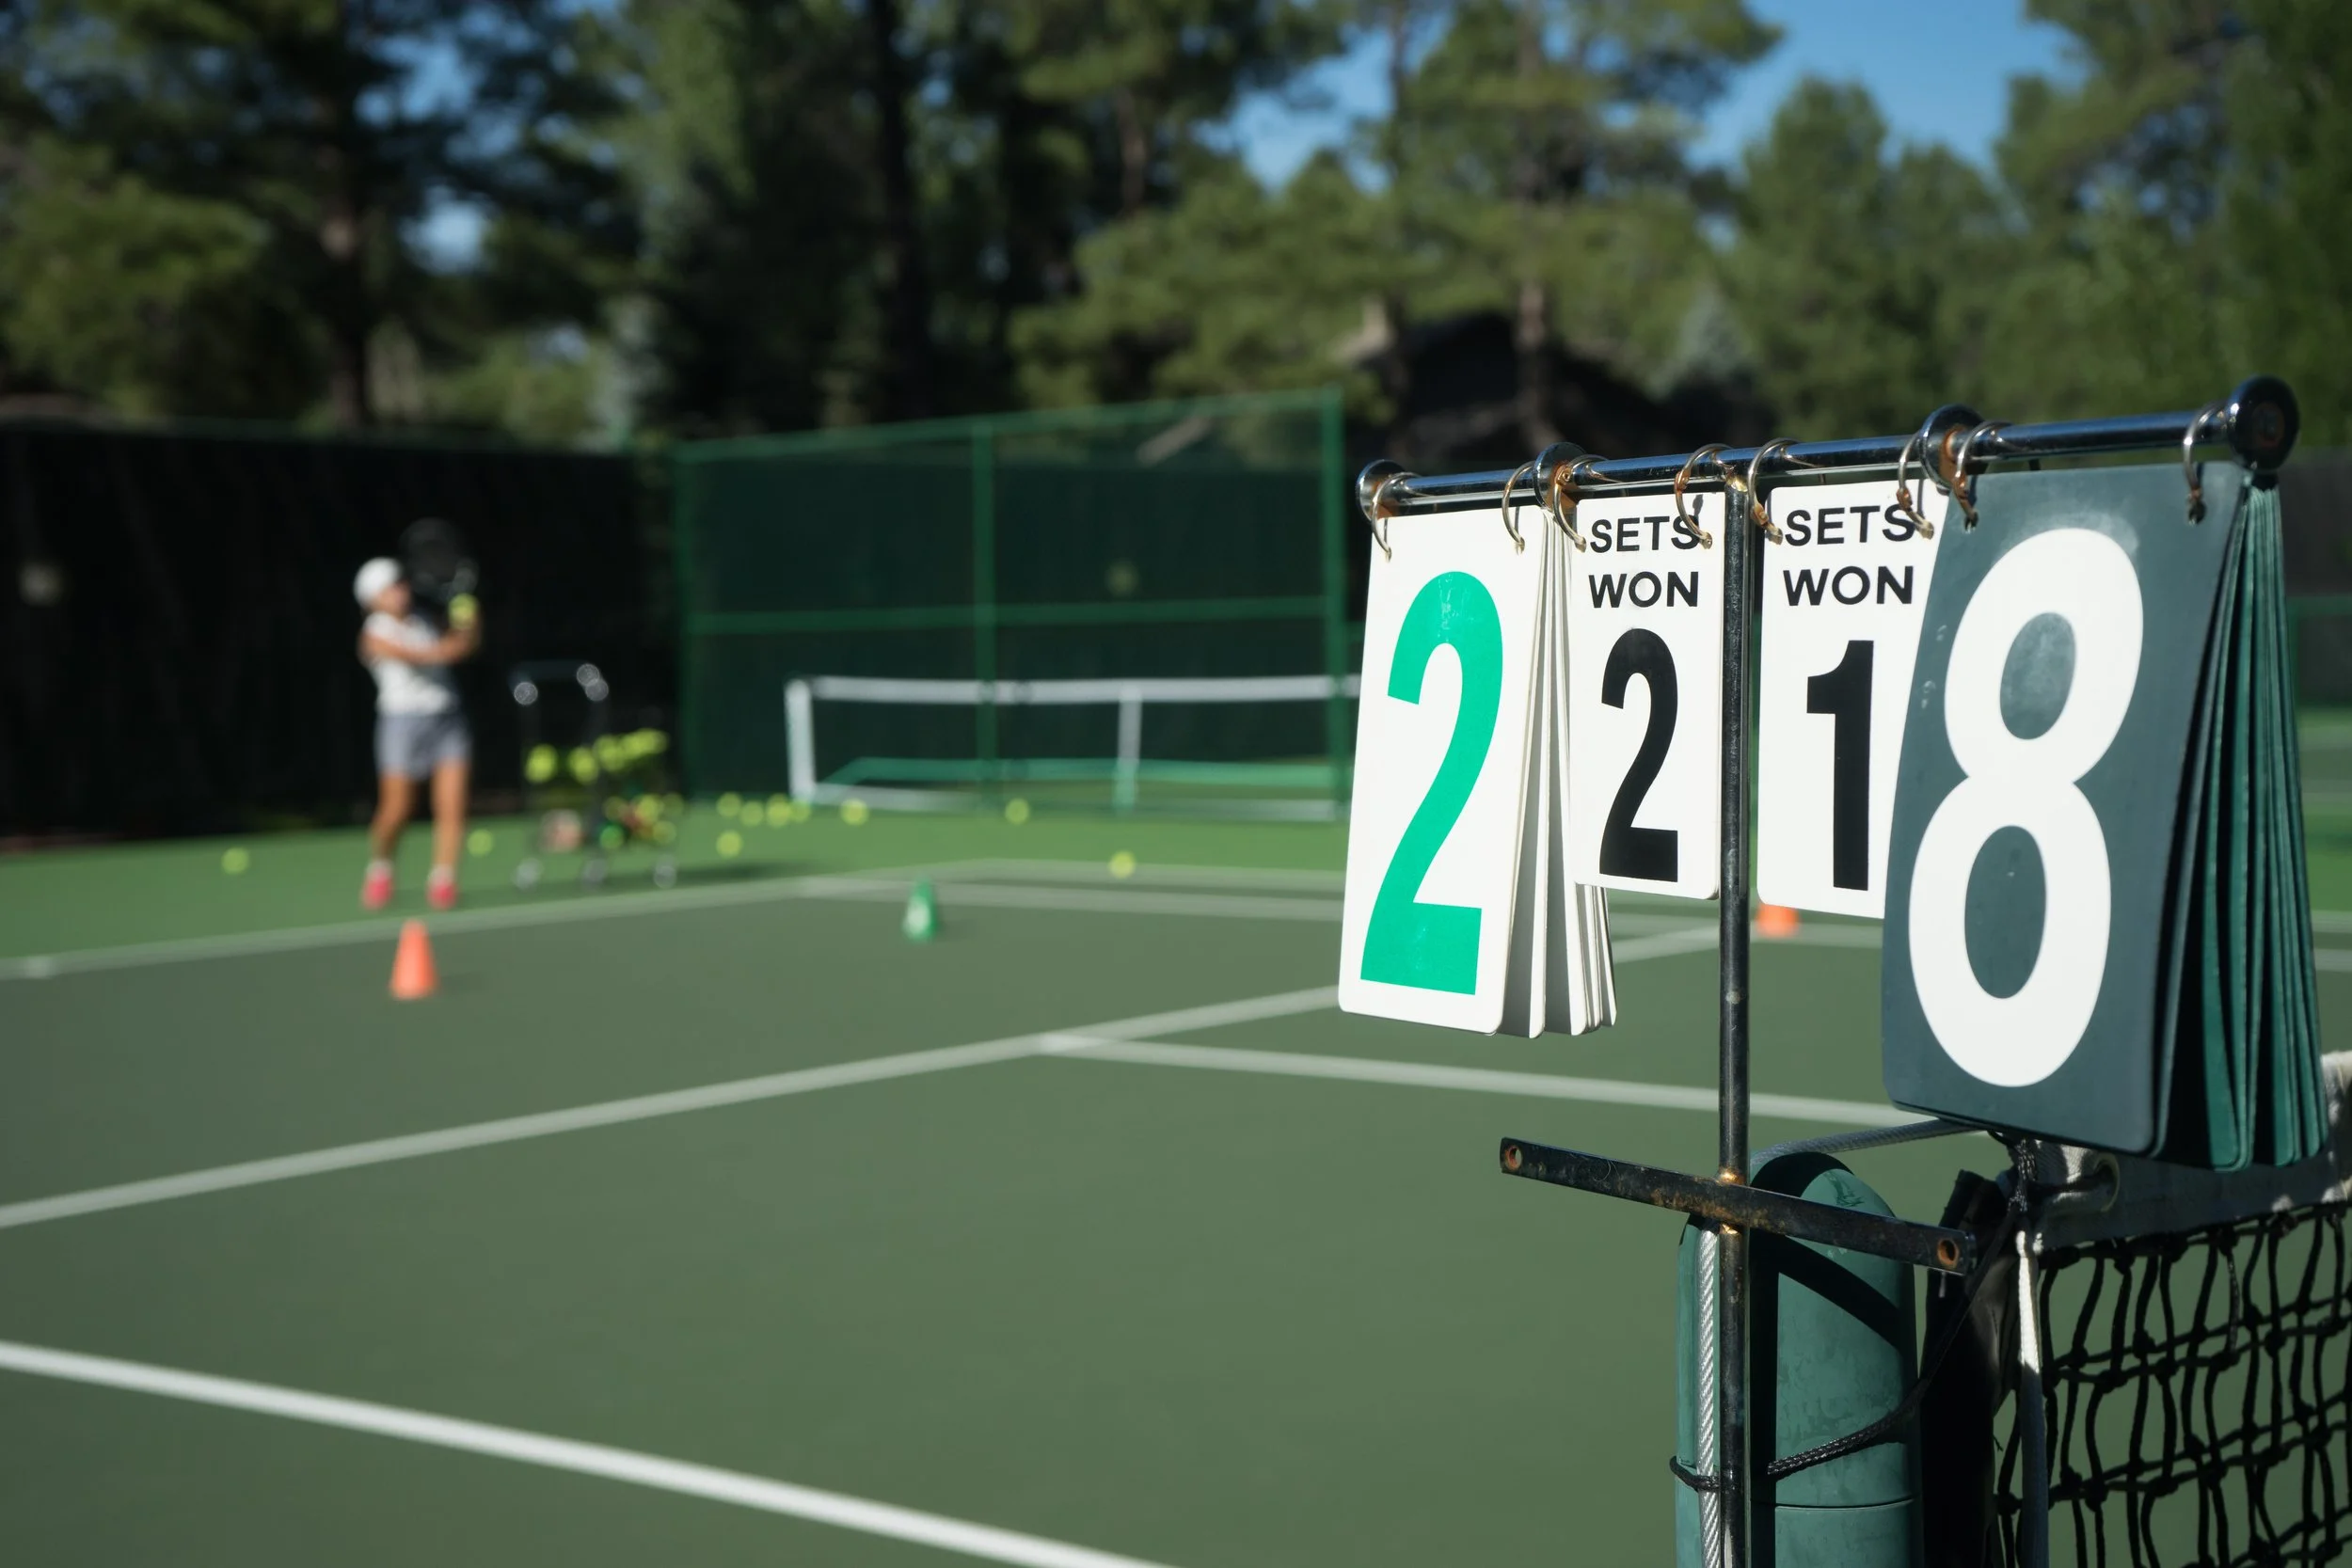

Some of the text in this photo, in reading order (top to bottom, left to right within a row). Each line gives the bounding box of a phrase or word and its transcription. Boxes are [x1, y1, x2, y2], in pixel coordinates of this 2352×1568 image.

[1588, 570, 1699, 609] WON
[1589, 515, 1700, 553] SETS
[1782, 564, 1914, 607] WON
[1785, 503, 1915, 546] SETS
[1359, 570, 1503, 996] 2
[1598, 627, 1679, 883] 2
[1805, 640, 1875, 891] 1
[1908, 527, 2144, 1087] 8
